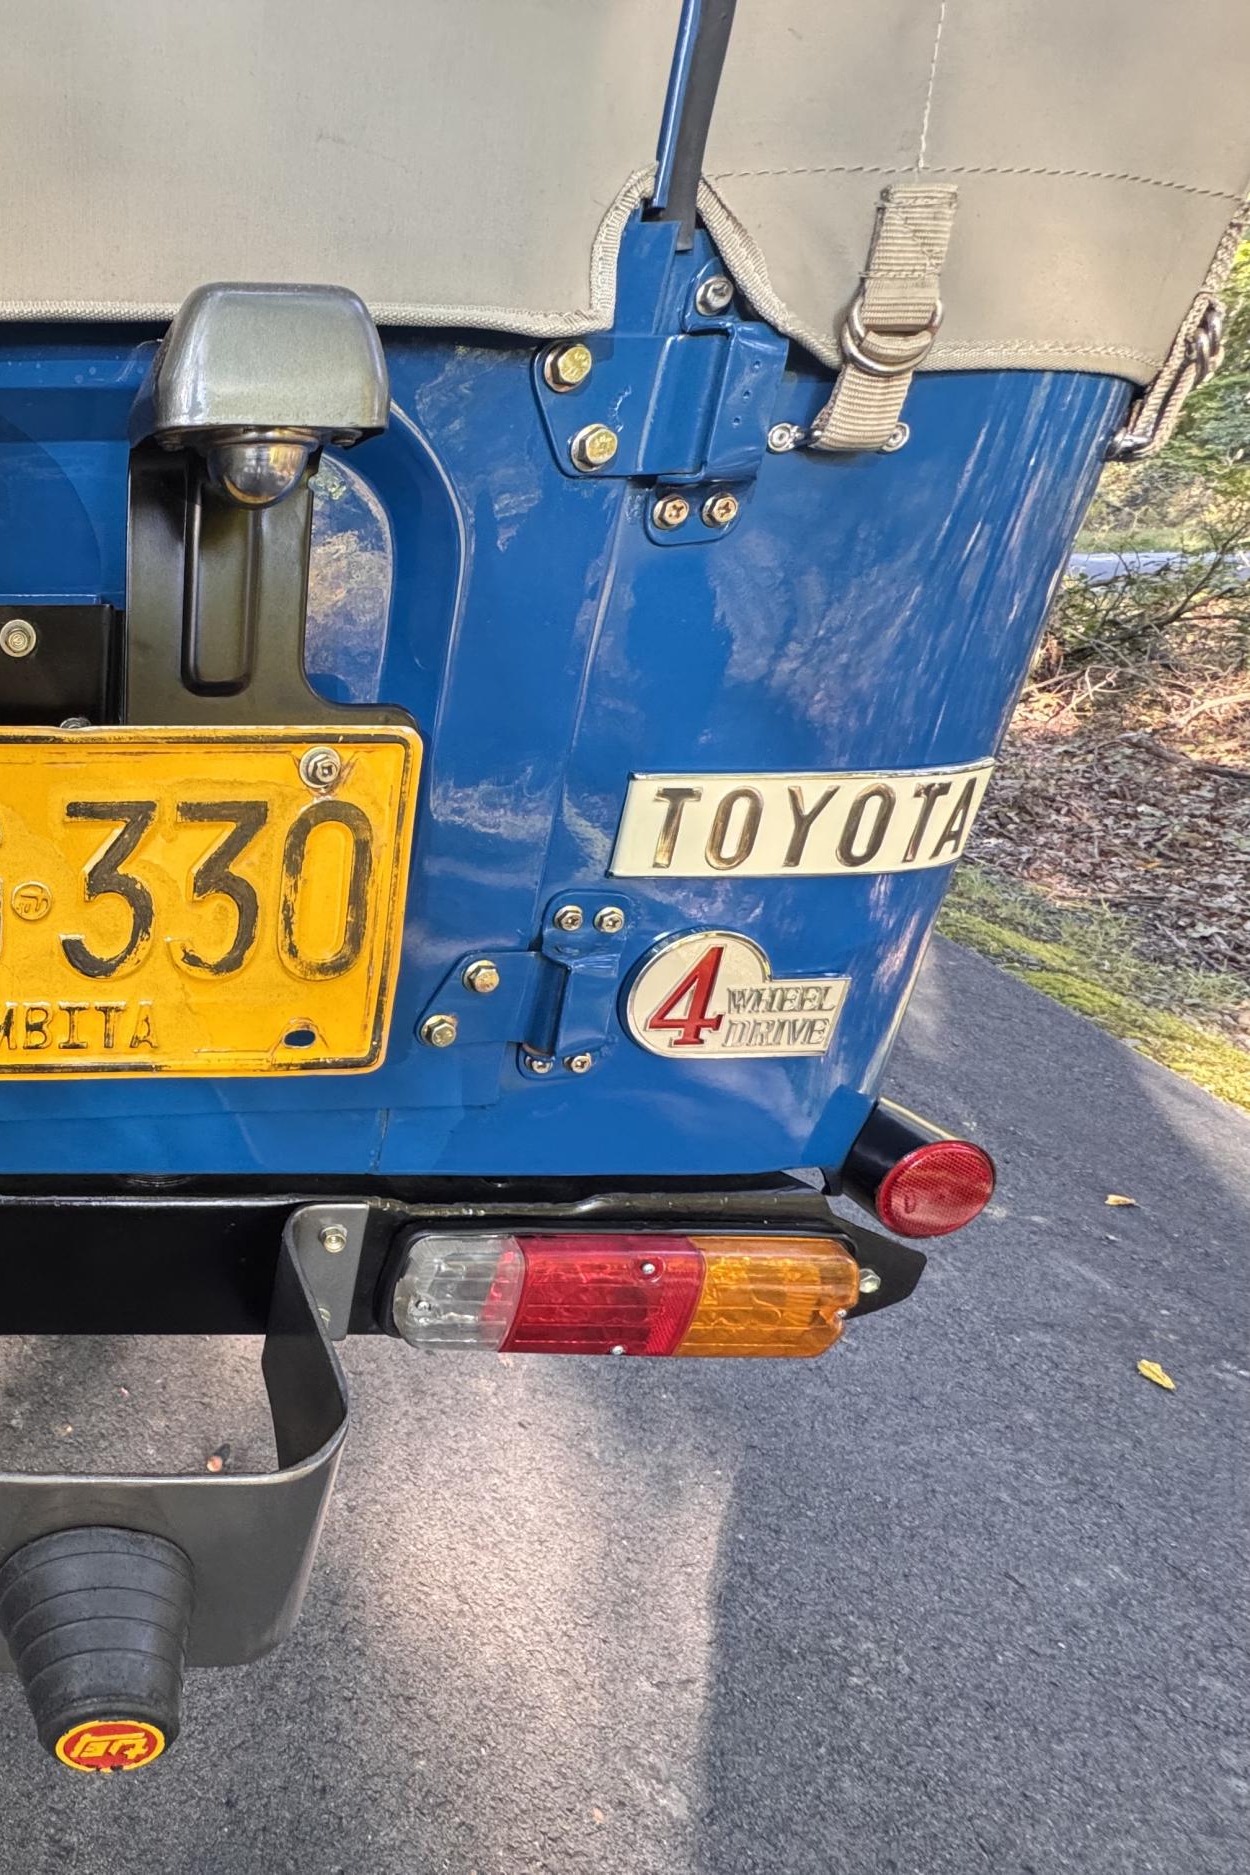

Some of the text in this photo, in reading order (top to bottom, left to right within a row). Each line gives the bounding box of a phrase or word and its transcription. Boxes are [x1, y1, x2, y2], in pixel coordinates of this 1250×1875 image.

[652, 777, 977, 870] TOYOTA
[59, 799, 375, 982] 330
[647, 945, 724, 1047] 4
[721, 1017, 831, 1048] DRIVE
[726, 984, 836, 1016] WHEEL
